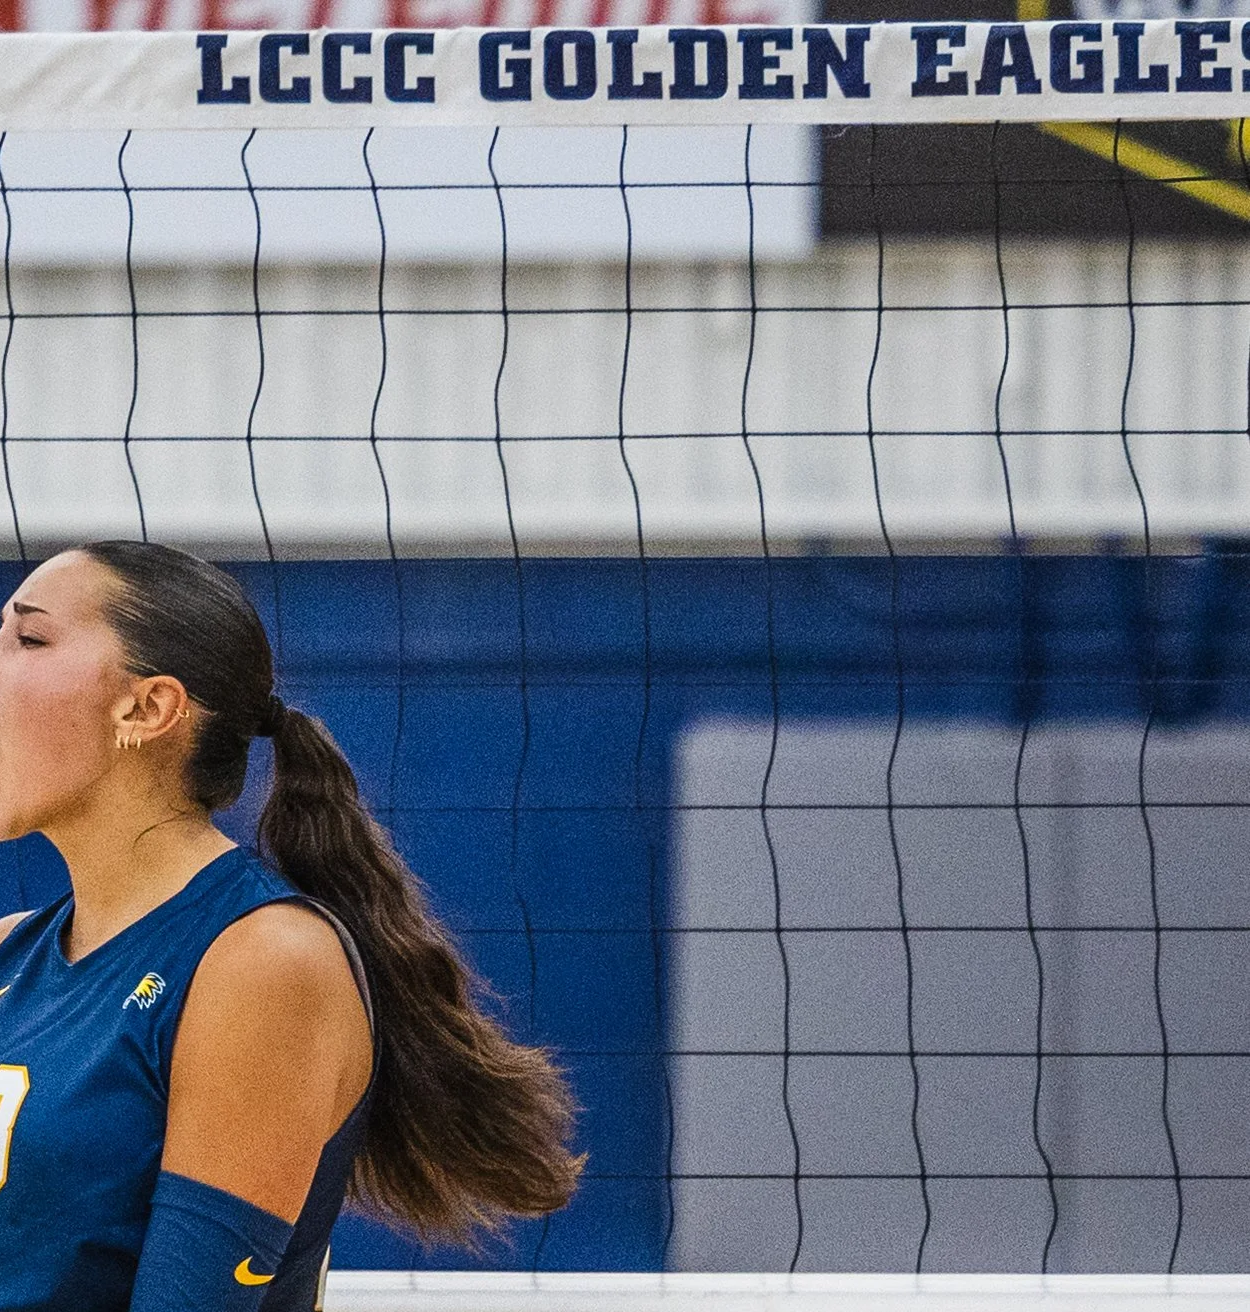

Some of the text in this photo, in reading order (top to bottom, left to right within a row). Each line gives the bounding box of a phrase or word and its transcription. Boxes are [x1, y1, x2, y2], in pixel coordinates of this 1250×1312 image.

[196, 21, 1250, 104] LCCC GOLDEN EAGLE
